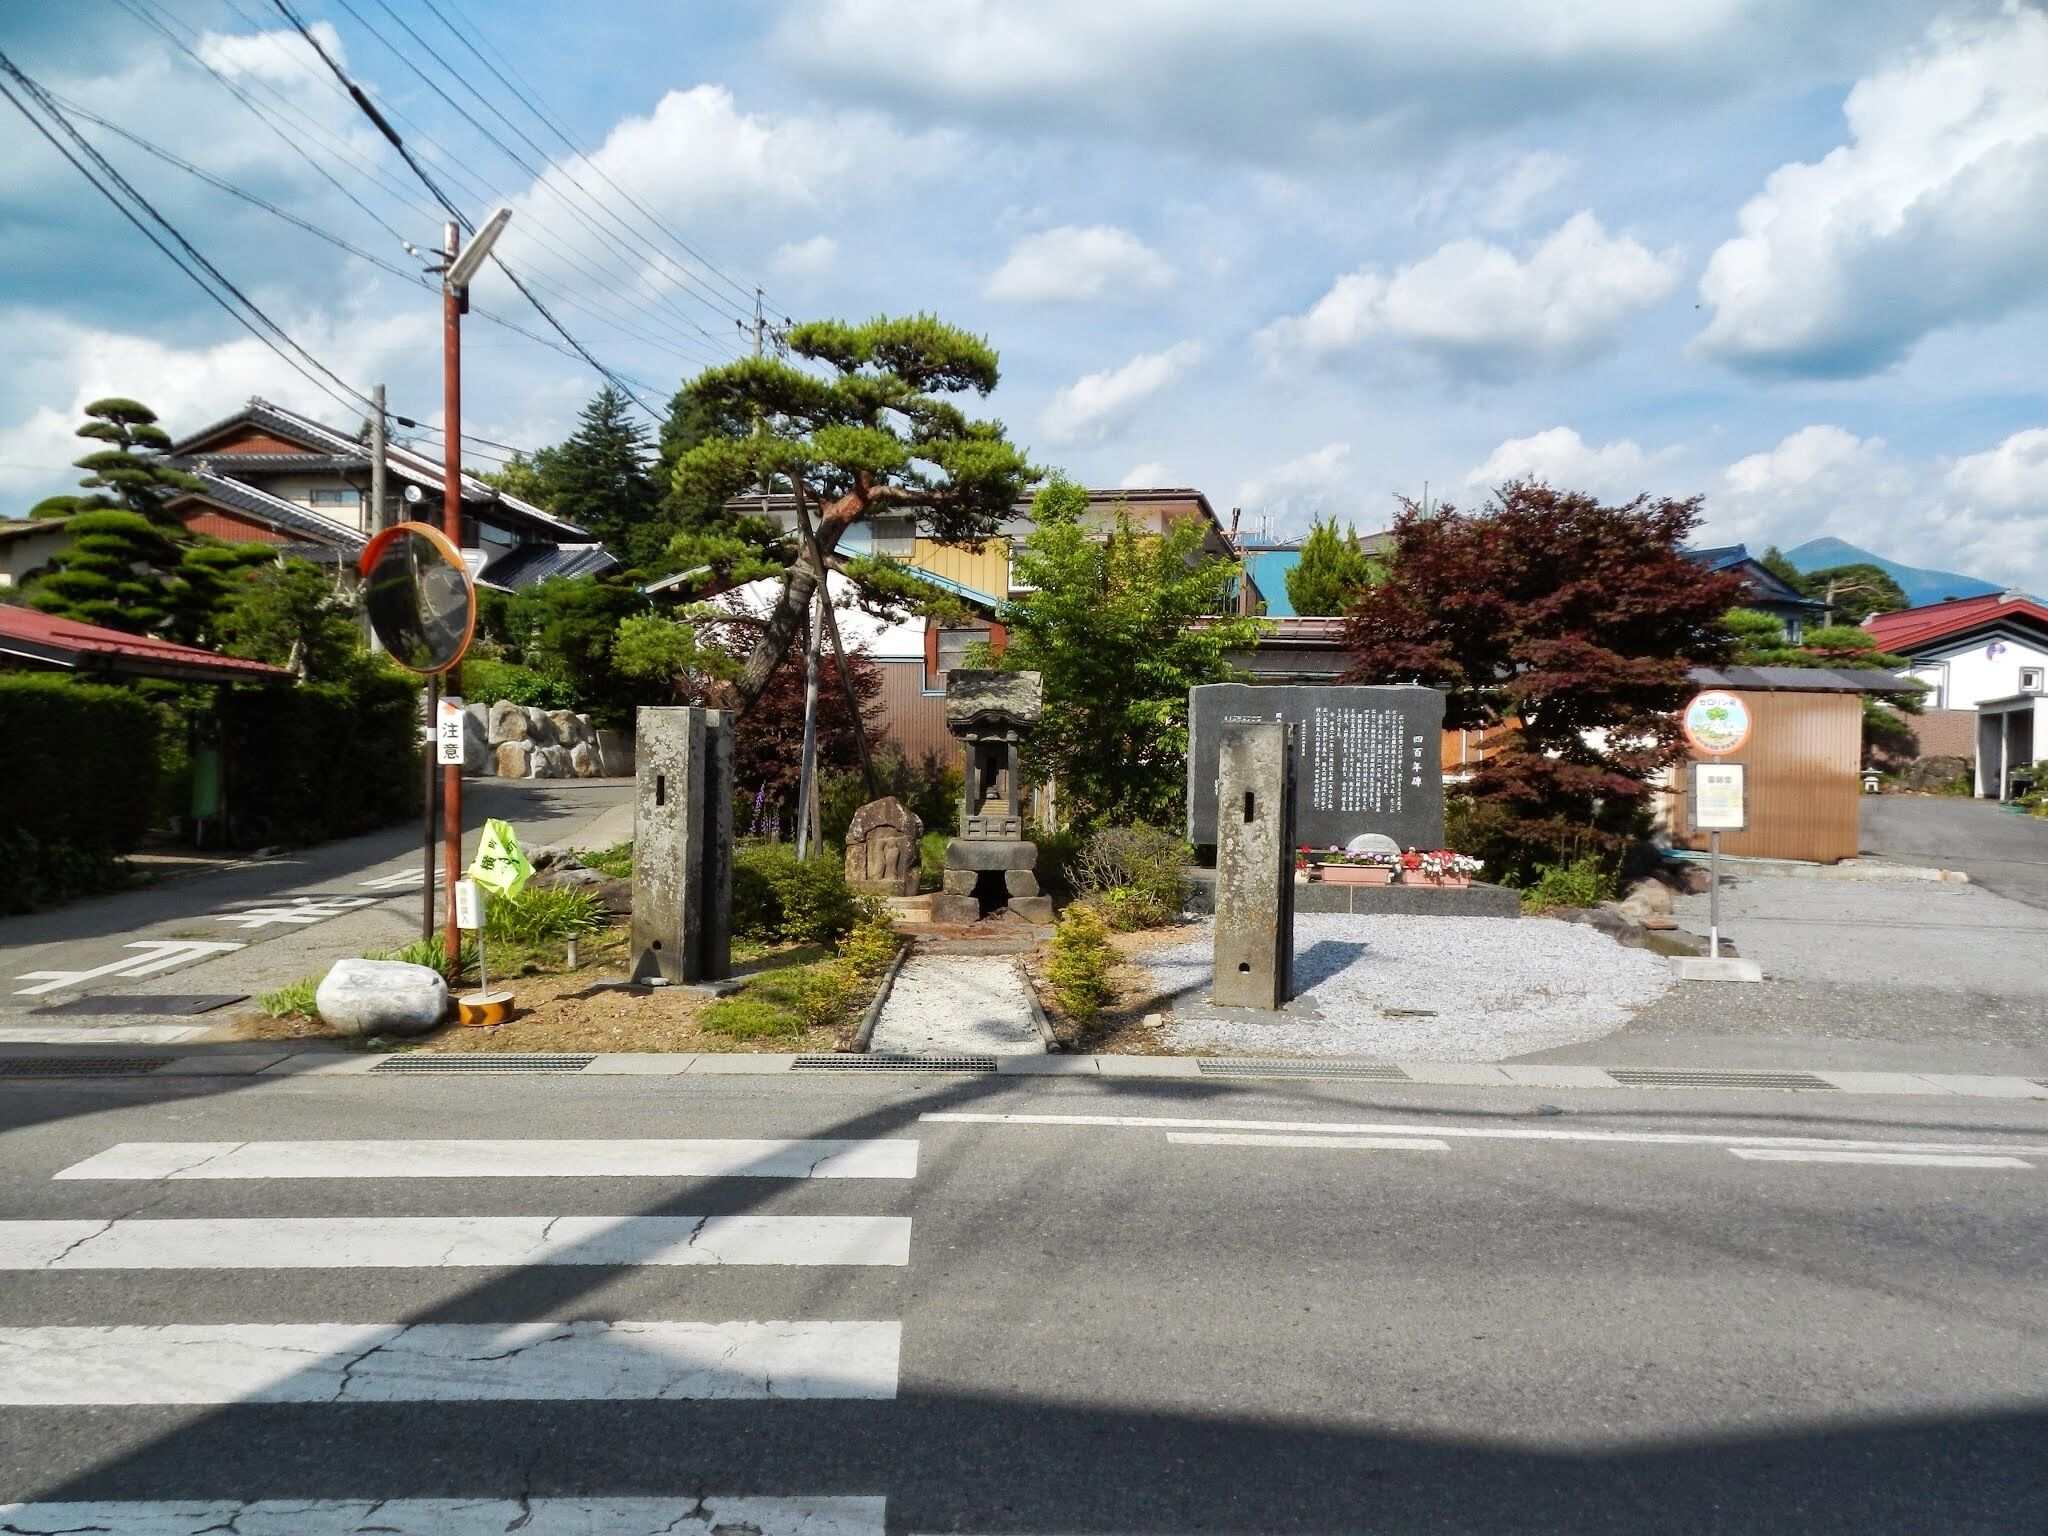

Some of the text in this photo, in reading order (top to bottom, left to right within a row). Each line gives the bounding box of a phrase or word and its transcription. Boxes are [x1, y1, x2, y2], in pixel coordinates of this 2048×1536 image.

[442, 722, 460, 760] 注意
[1410, 735, 1424, 788] 四百年碑
